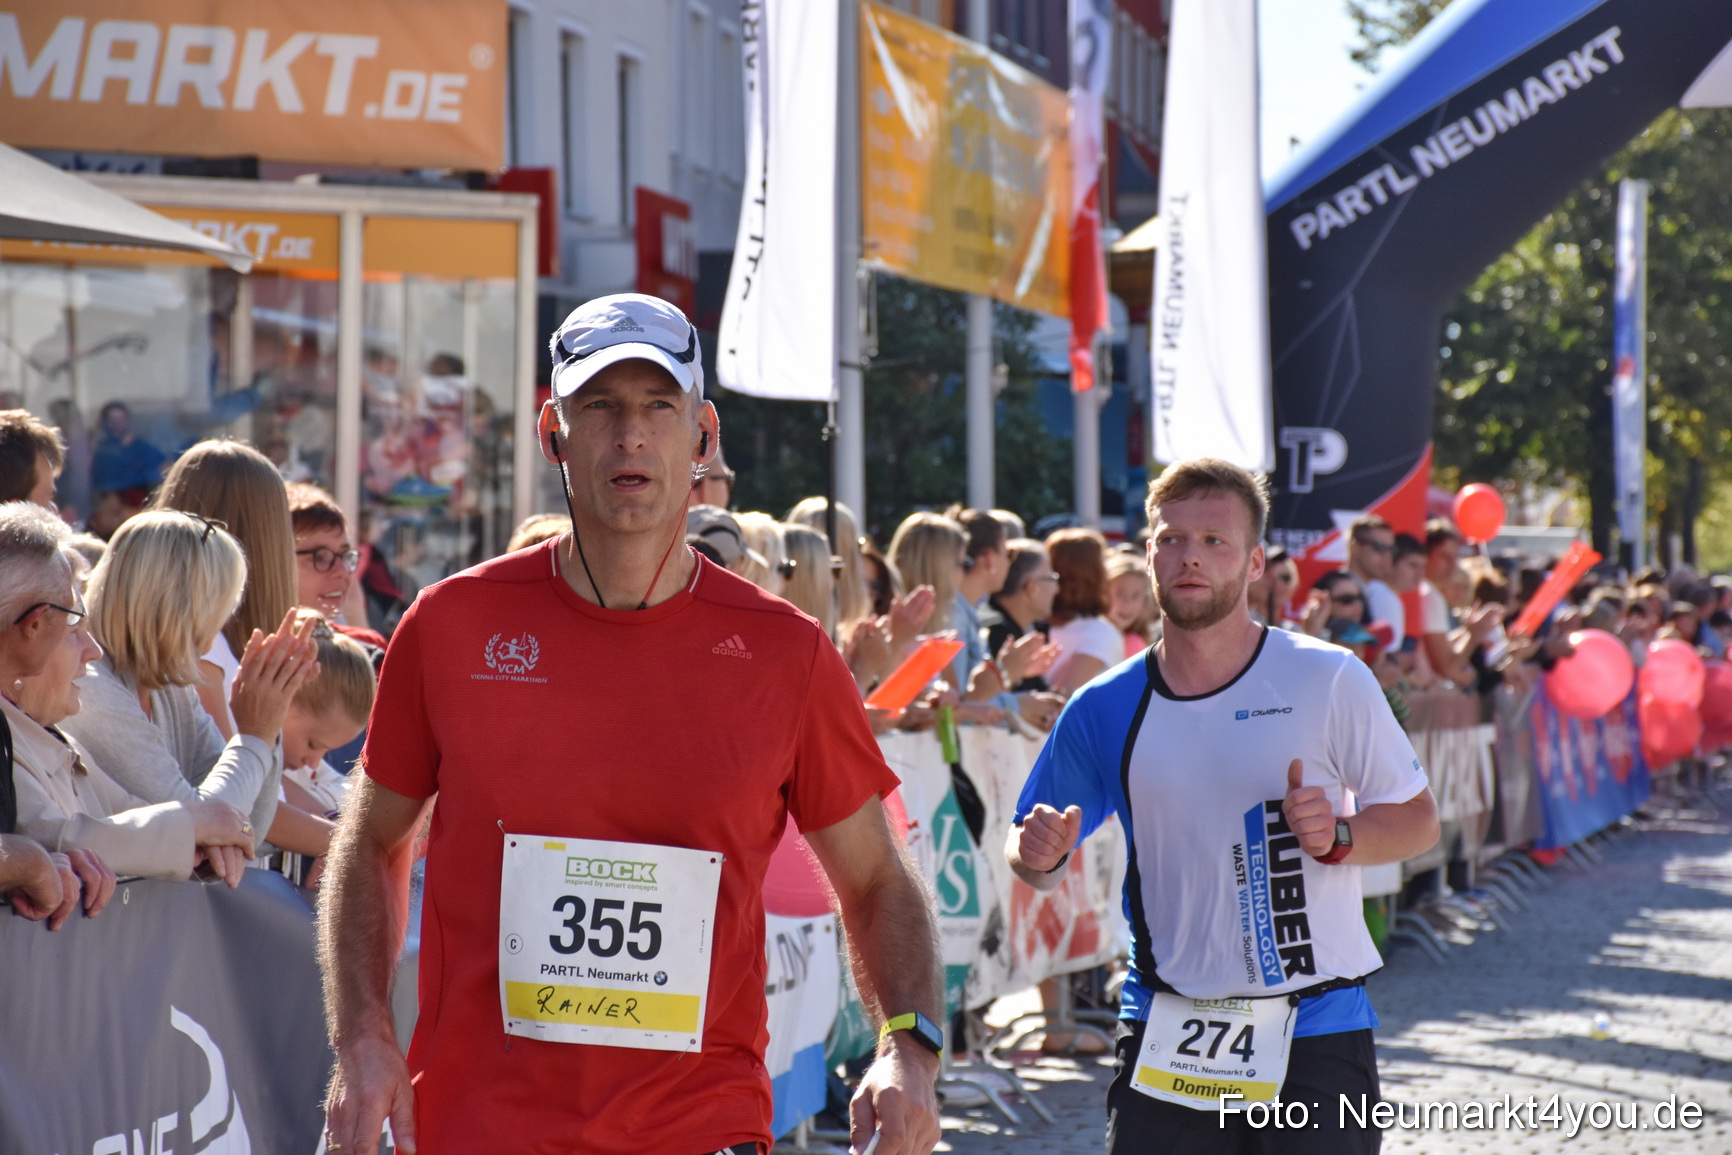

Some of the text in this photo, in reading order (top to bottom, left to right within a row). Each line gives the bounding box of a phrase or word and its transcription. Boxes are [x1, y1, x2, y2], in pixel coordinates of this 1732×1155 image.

[1289, 25, 1628, 249] PARTL NEUMARKT
[610, 325, 645, 333] adidas
[712, 646, 753, 660] adidas
[498, 664, 525, 674] VCM
[566, 856, 657, 883] BOCK
[565, 878, 593, 886] inspired
[595, 880, 603, 888] by
[627, 884, 658, 892] concepts
[1265, 799, 1317, 981] HUBER
[1232, 843, 1257, 985] WASTE WATER Solutions
[1250, 840, 1280, 977] TECHNOLOGY
[549, 895, 662, 960] 355
[540, 964, 649, 982] PARTL Neumarkt
[537, 985, 640, 1024] RAINER
[1176, 1019, 1255, 1063] 274
[1169, 1061, 1243, 1076] PARTL Neumarkt
[1172, 1078, 1243, 1098] Dominic
